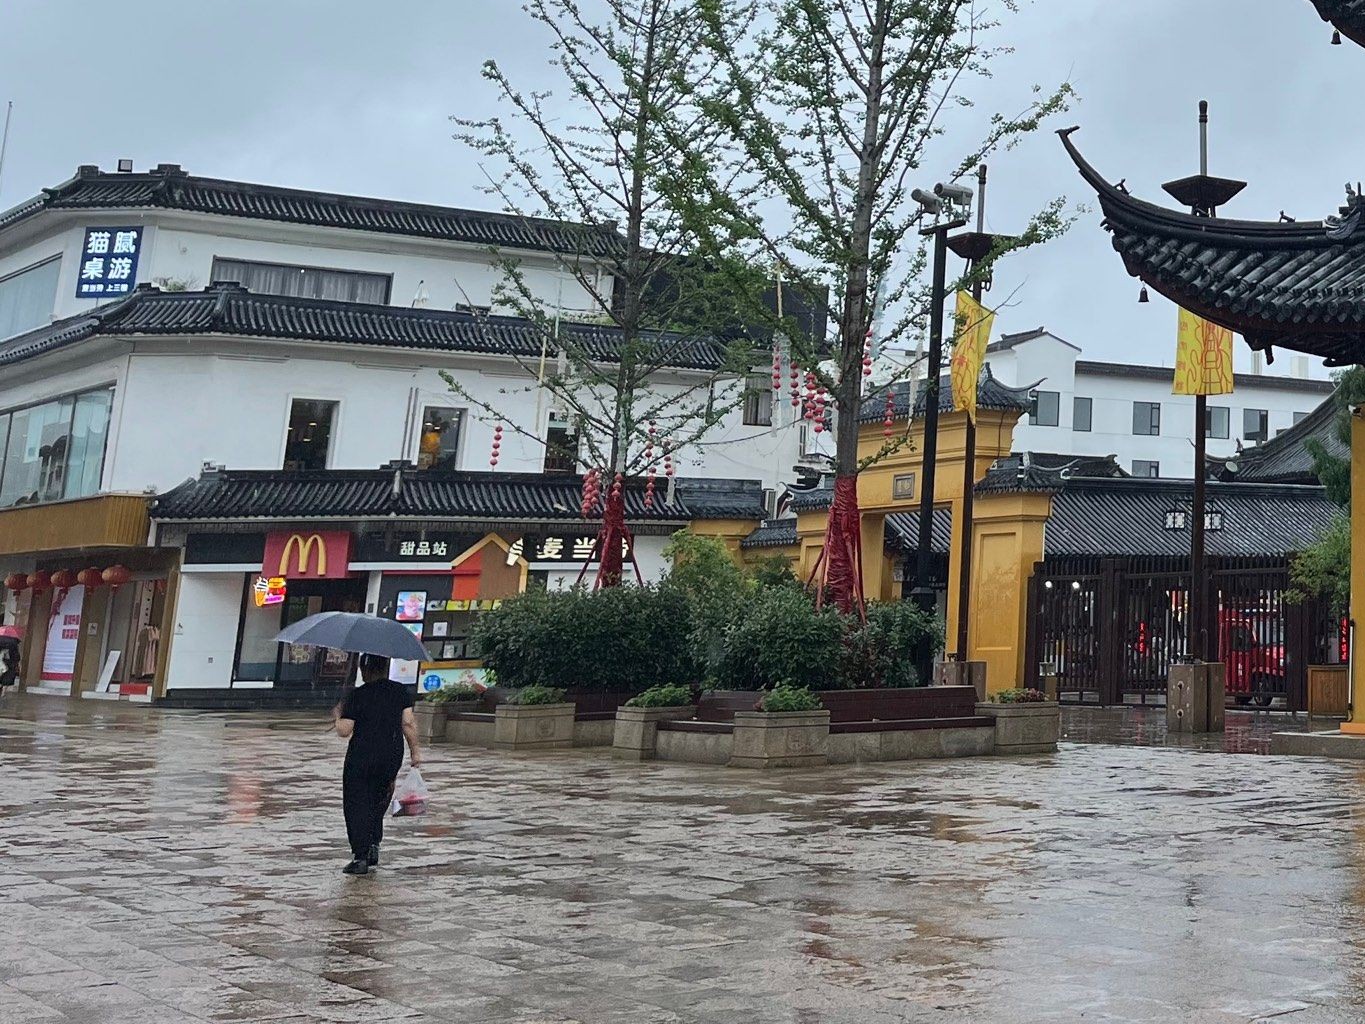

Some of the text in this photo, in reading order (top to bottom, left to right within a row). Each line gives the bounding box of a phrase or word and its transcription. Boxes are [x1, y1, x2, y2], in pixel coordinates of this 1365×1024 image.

[87, 231, 137, 253] 猫腻
[82, 257, 132, 279] 桌游
[400, 541, 447, 556] 甜品站
